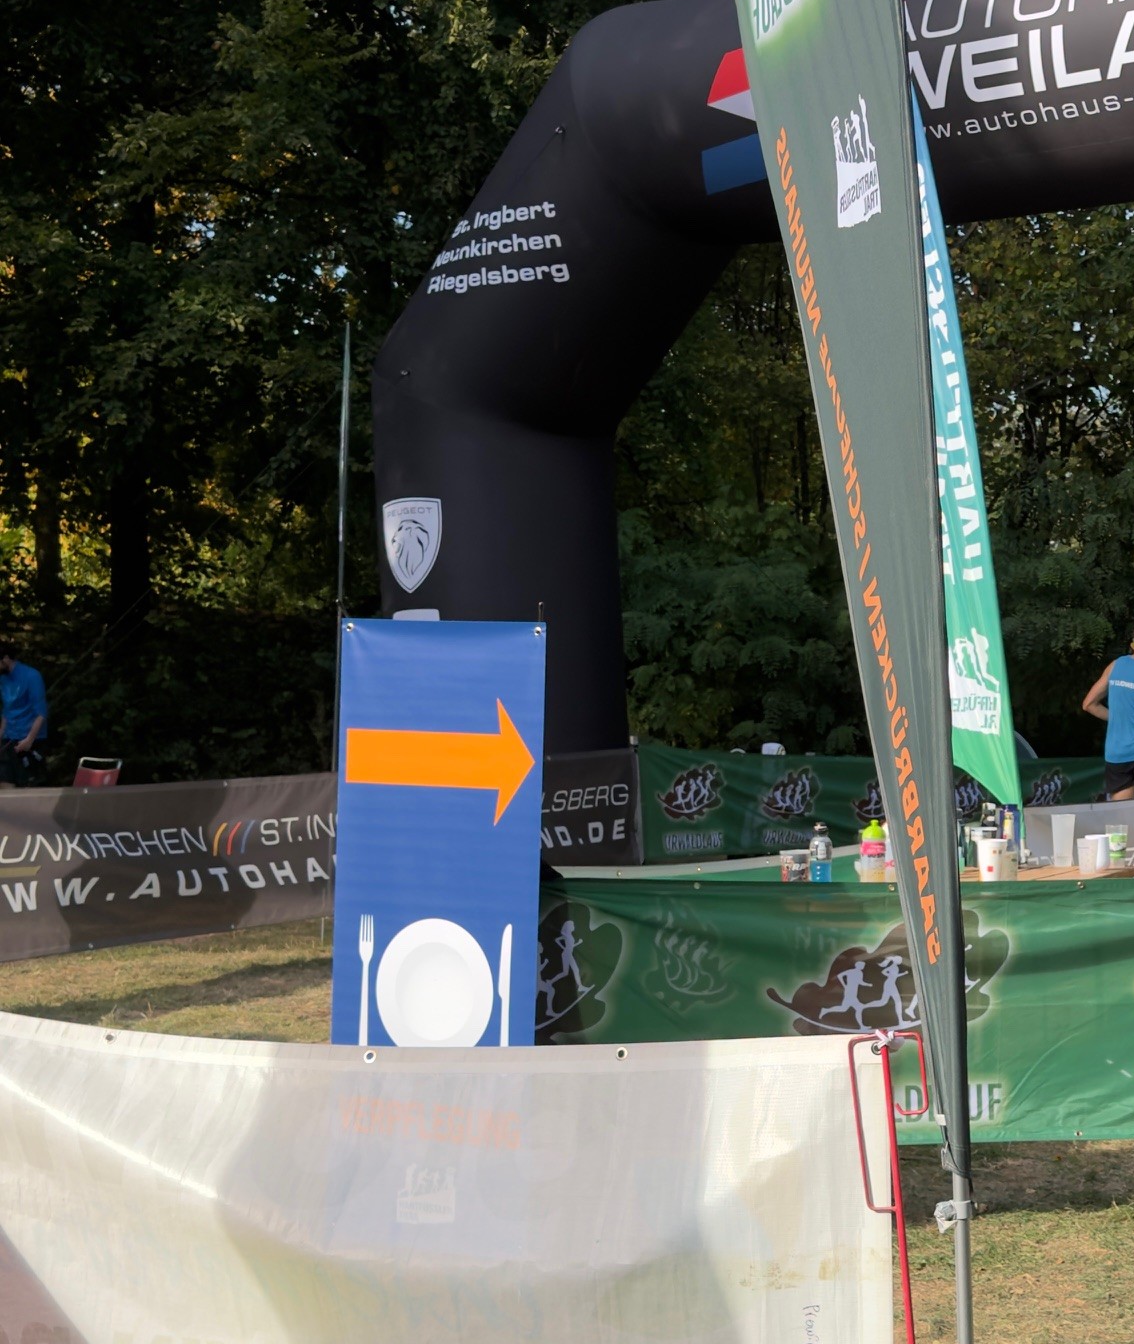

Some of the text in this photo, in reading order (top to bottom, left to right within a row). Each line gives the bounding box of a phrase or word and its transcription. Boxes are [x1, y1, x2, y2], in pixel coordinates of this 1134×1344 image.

[473, 201, 556, 230] Ingbert
[431, 233, 562, 270] Neunkirchen
[427, 263, 570, 294] Riegelsberg
[387, 506, 433, 519] PEUGEOT
[0, 783, 629, 864] UNKIRCHEN ST.IN LSBERG
